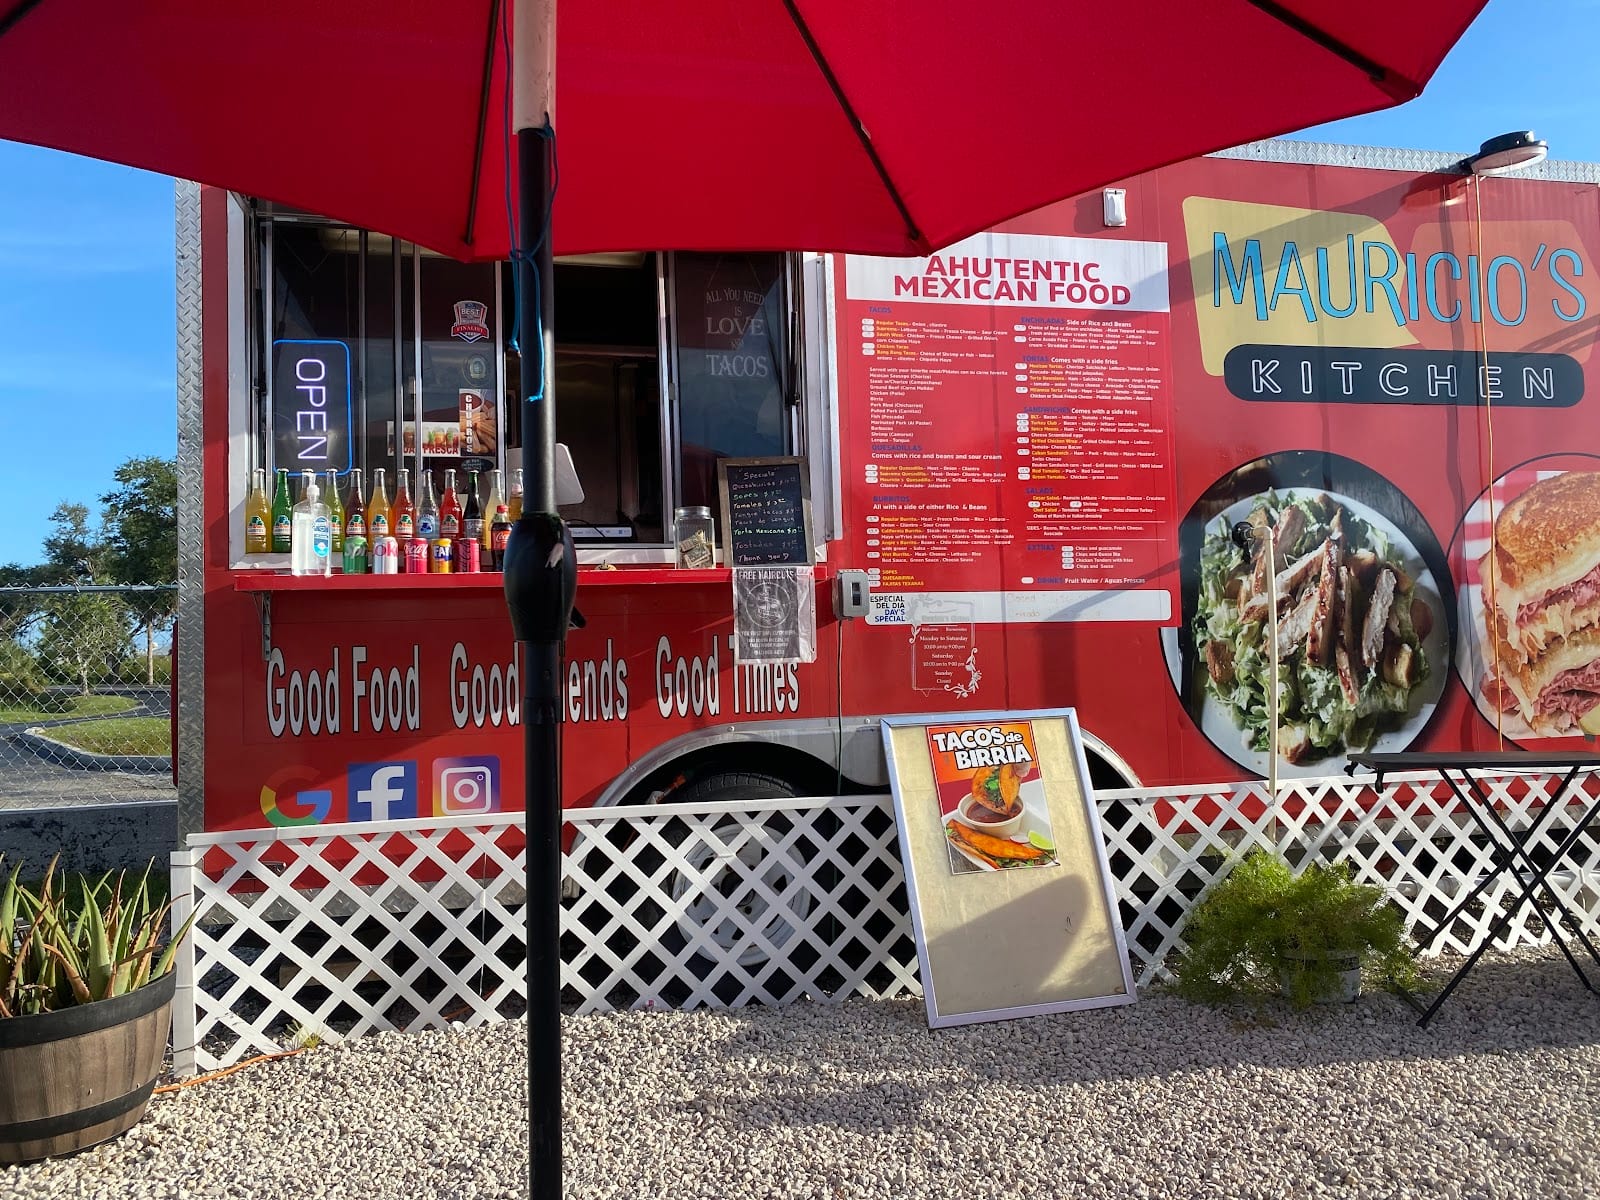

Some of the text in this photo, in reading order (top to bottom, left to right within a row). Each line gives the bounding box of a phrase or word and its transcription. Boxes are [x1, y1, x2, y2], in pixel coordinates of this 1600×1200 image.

[926, 256, 1100, 282] AHUTENTIC
[1213, 232, 1586, 327] MAURICIO'S
[706, 288, 764, 305] ALL YOU NEED
[894, 276, 1132, 304] MEXICAN FOOD
[706, 316, 765, 336] LOVE
[706, 354, 768, 377] TACOS
[1251, 359, 1554, 399] KITCHEN
[296, 358, 327, 459] OPEN
[739, 571, 756, 579] FREE
[266, 647, 340, 738] Good
[352, 646, 420, 732] Food
[450, 642, 520, 728] Good
[562, 638, 628, 722] ends
[656, 635, 719, 718] Good
[933, 727, 1023, 752] TACOS de
[954, 743, 1033, 770] BIRRIA
